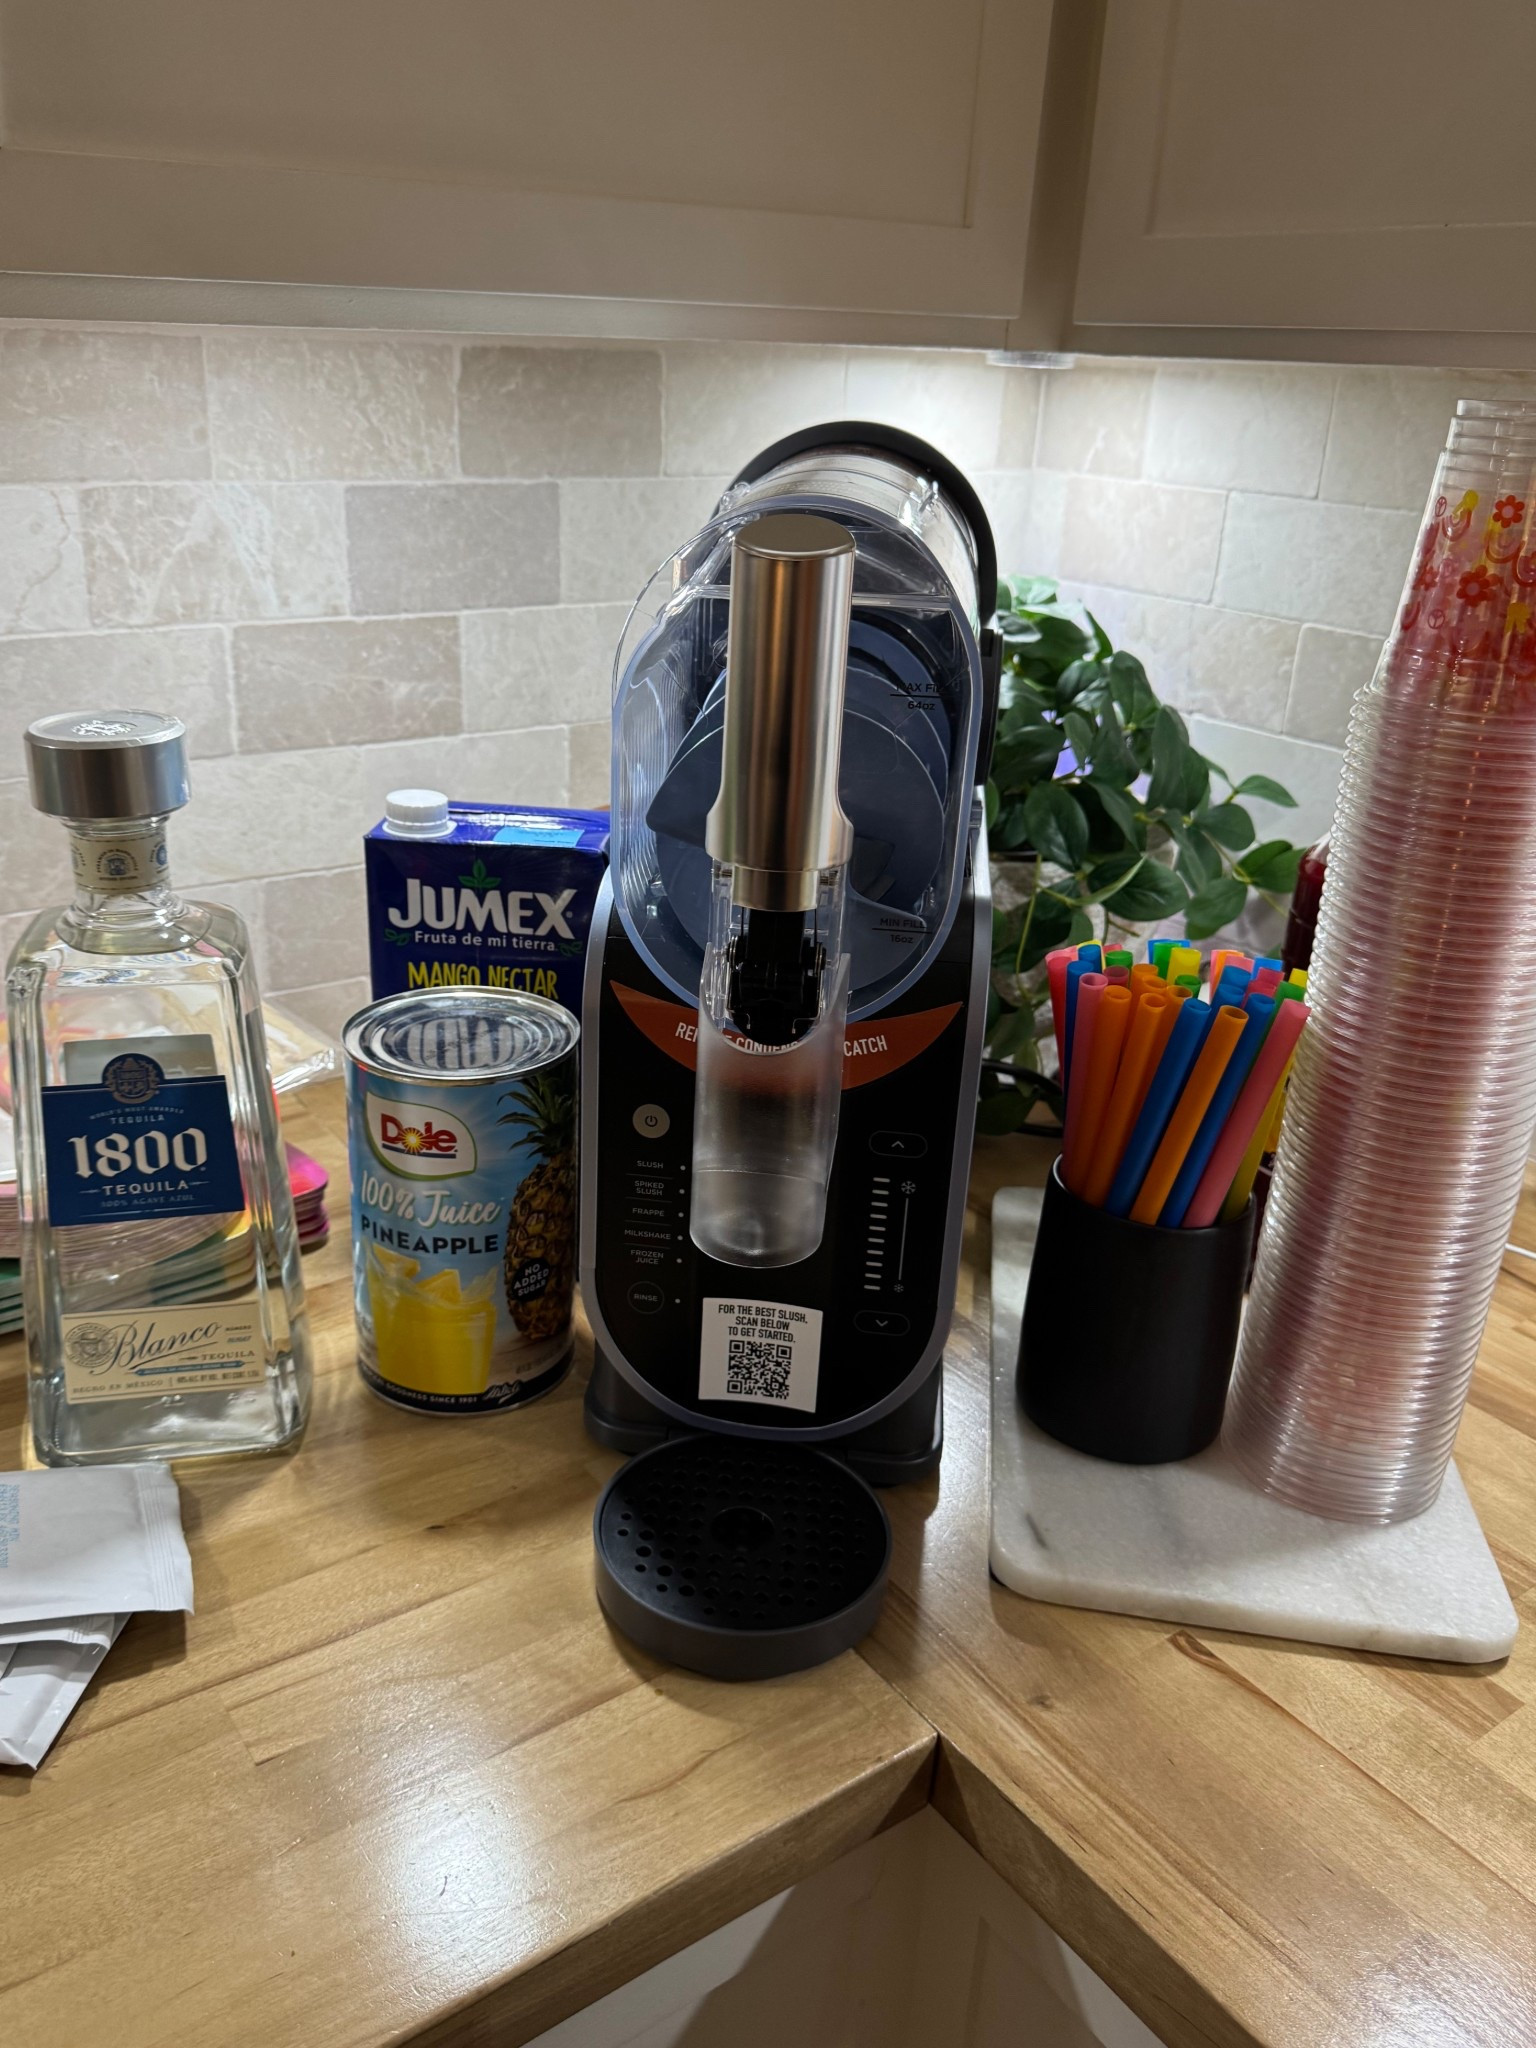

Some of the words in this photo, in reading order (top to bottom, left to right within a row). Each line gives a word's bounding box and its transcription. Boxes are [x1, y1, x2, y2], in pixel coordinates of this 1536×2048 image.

[907, 700, 936, 711] 64oz
[387, 877, 579, 940] JUMEX
[879, 917, 901, 927] MIN
[902, 919, 926, 929] FILL
[414, 930, 457, 945] Fruta
[461, 932, 483, 946] de
[487, 934, 507, 948] mi
[511, 936, 556, 952] tierra
[889, 934, 914, 944] 16oz
[407, 960, 481, 990] MANGO
[487, 964, 559, 1000] NECTAR
[843, 1034, 888, 1057] CATCH
[109, 1113, 166, 1125] TEQUILA
[380, 1112, 458, 1154] Dole
[66, 1126, 209, 1180] 1800
[636, 1160, 663, 1169] SLUSH
[101, 1179, 190, 1197] TEQUILA
[634, 1180, 664, 1189] SPIKED
[635, 1187, 662, 1196] SLUSH
[360, 1169, 416, 1221] 100%
[416, 1189, 502, 1230] Juice
[360, 1214, 500, 1255] PINEAPPLE
[624, 1229, 671, 1240] MILKSHAKE
[630, 1249, 664, 1259] FROZEN
[635, 1256, 659, 1265] JUICE
[524, 1263, 541, 1277] NO
[512, 1268, 550, 1290] ADDED
[517, 1279, 547, 1298] SUGAR
[633, 1293, 658, 1301] RINSE
[718, 1303, 735, 1314] FOR
[737, 1304, 753, 1315] THE
[755, 1306, 776, 1317] BEST
[778, 1309, 807, 1323] SLUSH.
[735, 1316, 758, 1327] SCAN
[760, 1318, 790, 1330] BELOW
[728, 1326, 738, 1335] TO
[740, 1327, 757, 1337] GET
[758, 1329, 796, 1342] STARTED.
[89, 1319, 222, 1376] Blanco
[201, 1349, 256, 1361] TEQUILA
